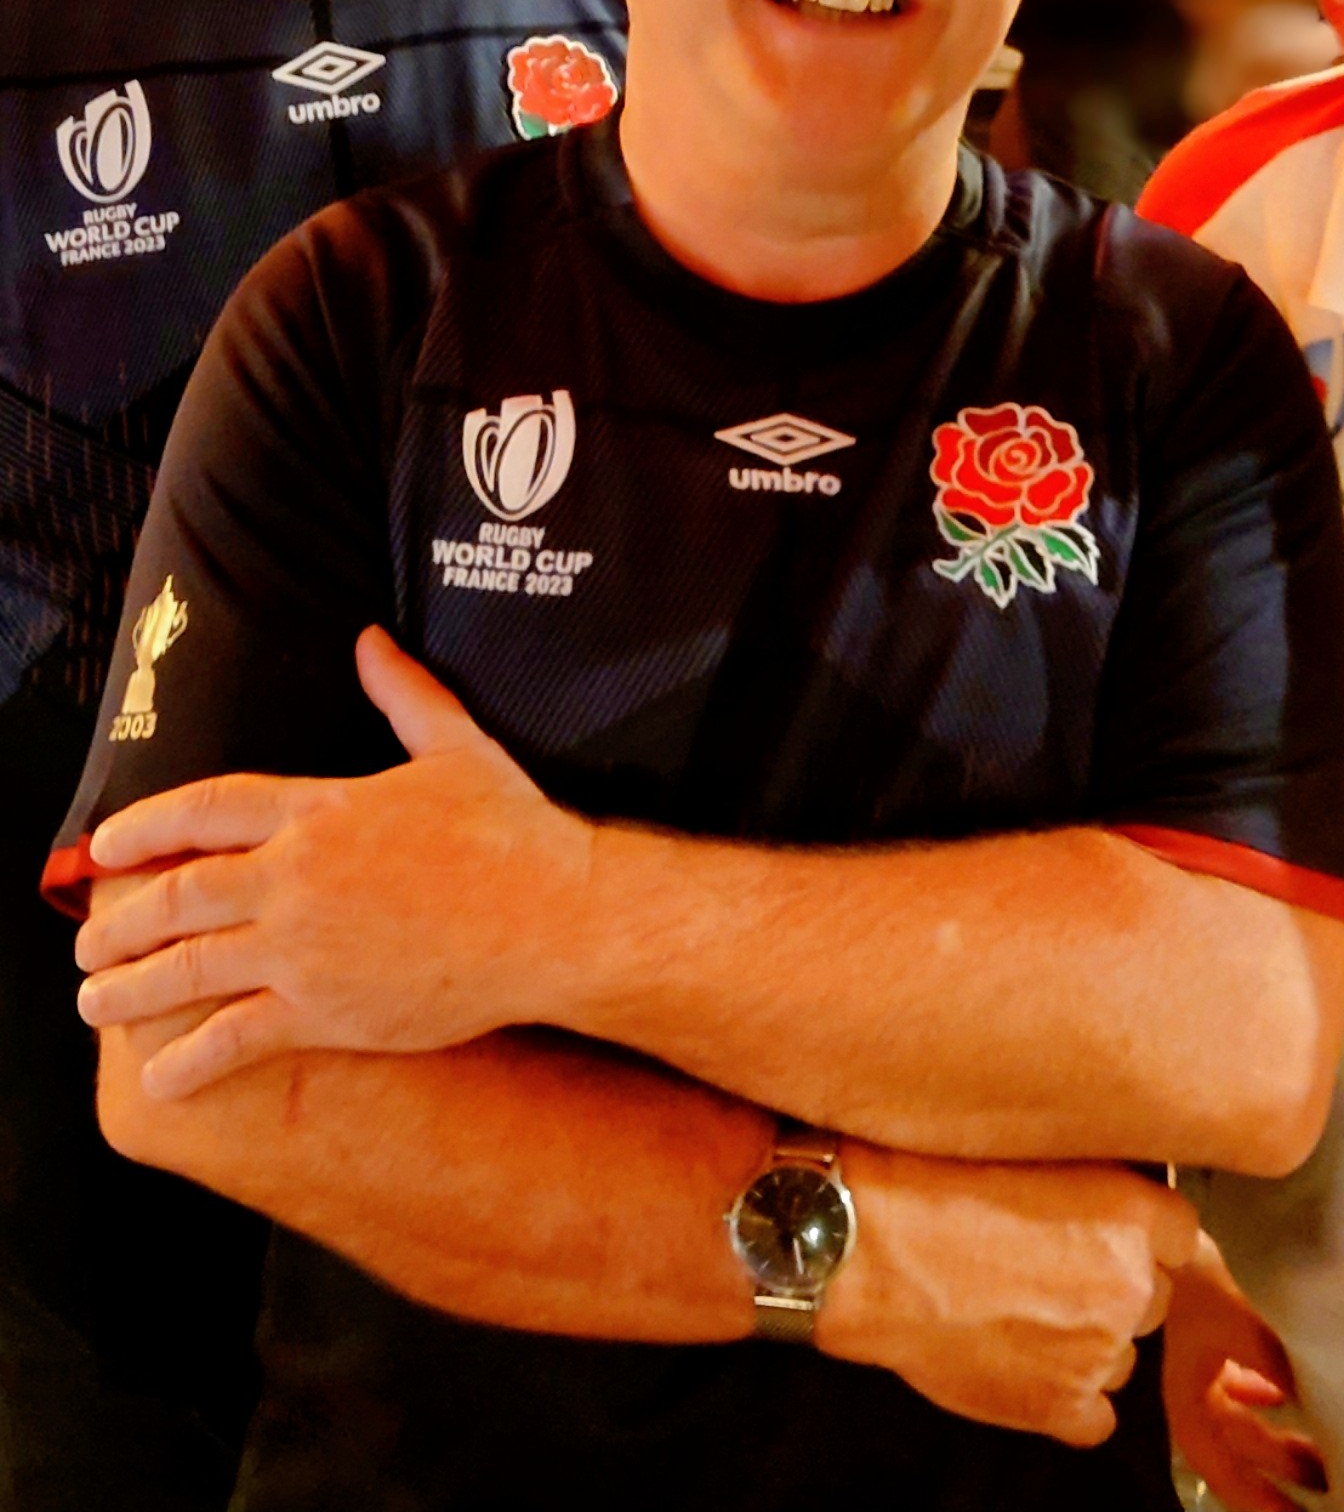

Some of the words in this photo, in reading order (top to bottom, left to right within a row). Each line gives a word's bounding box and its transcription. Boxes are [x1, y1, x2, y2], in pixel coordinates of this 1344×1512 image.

[288, 93, 381, 124] umbro
[83, 203, 137, 226] RUGBY
[44, 221, 131, 253] WORLD
[134, 211, 180, 237] CUP
[60, 242, 121, 267] FRANCE
[124, 234, 166, 255] 2023
[729, 467, 842, 497] umbro
[478, 522, 546, 549] RUGBY
[432, 539, 531, 571] WORLD
[535, 550, 594, 575] CUP
[443, 566, 520, 592] FRANCE
[524, 572, 573, 596] 2023
[109, 712, 157, 742] 2003
